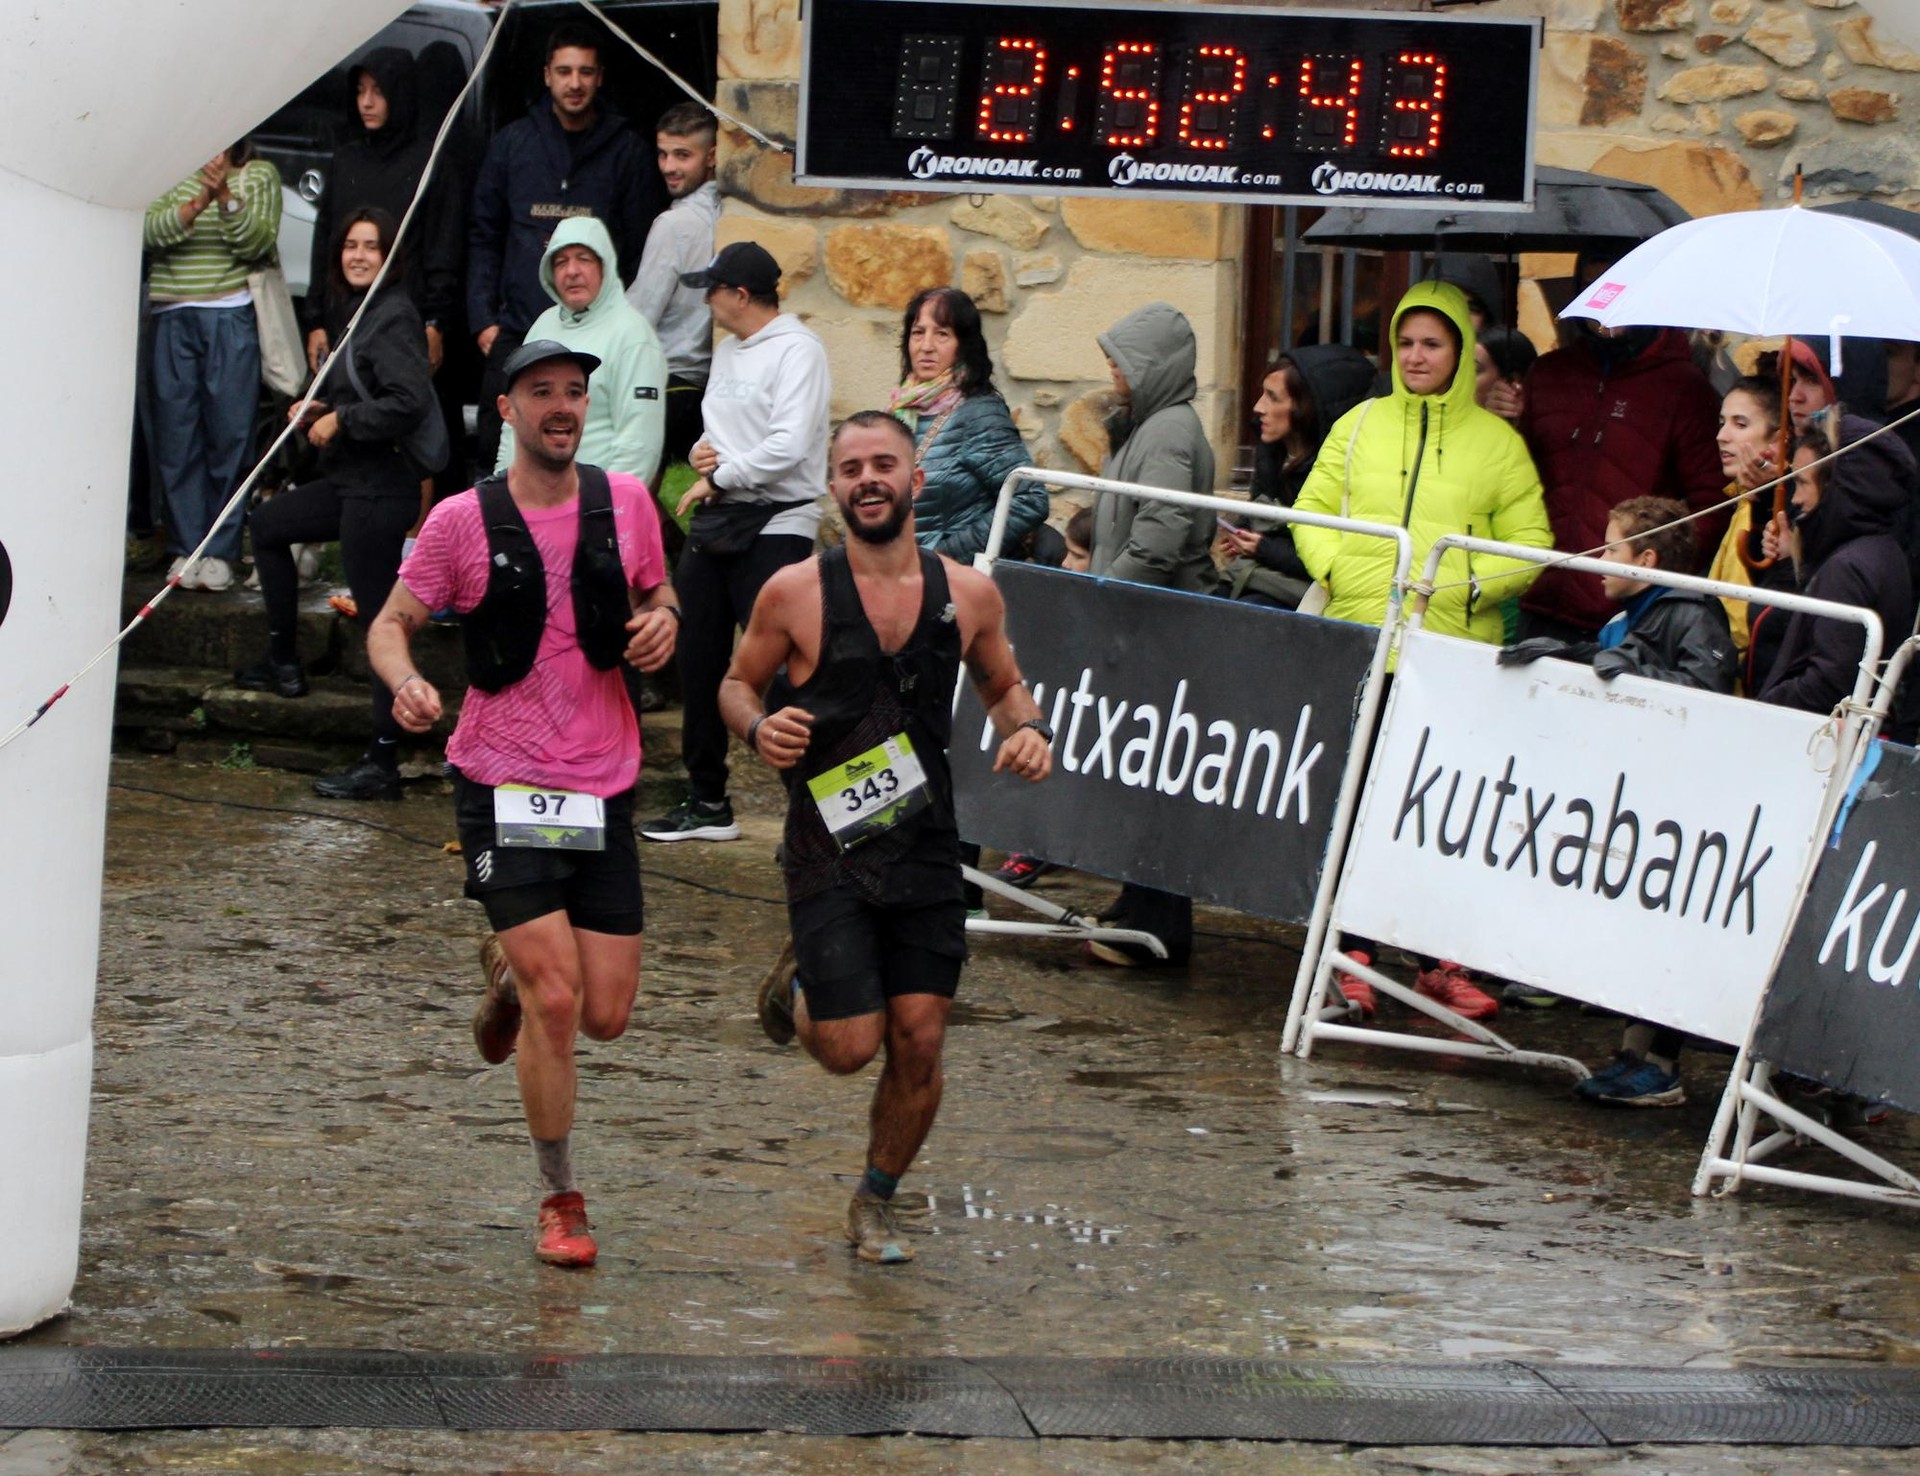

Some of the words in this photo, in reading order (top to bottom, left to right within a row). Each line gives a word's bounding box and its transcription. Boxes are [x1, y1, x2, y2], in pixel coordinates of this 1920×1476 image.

[977, 38, 1452, 158] 2:52:43
[907, 145, 1082, 180] KRONOAK.com
[1108, 152, 1281, 186] KRONOAK.com
[1311, 161, 1484, 195] KRONOAK.com
[980, 643, 1324, 825] txabank
[528, 793, 567, 816] 97
[840, 768, 899, 812] 343
[1392, 725, 1775, 936] kutxabank
[1818, 840, 1920, 987] ku
